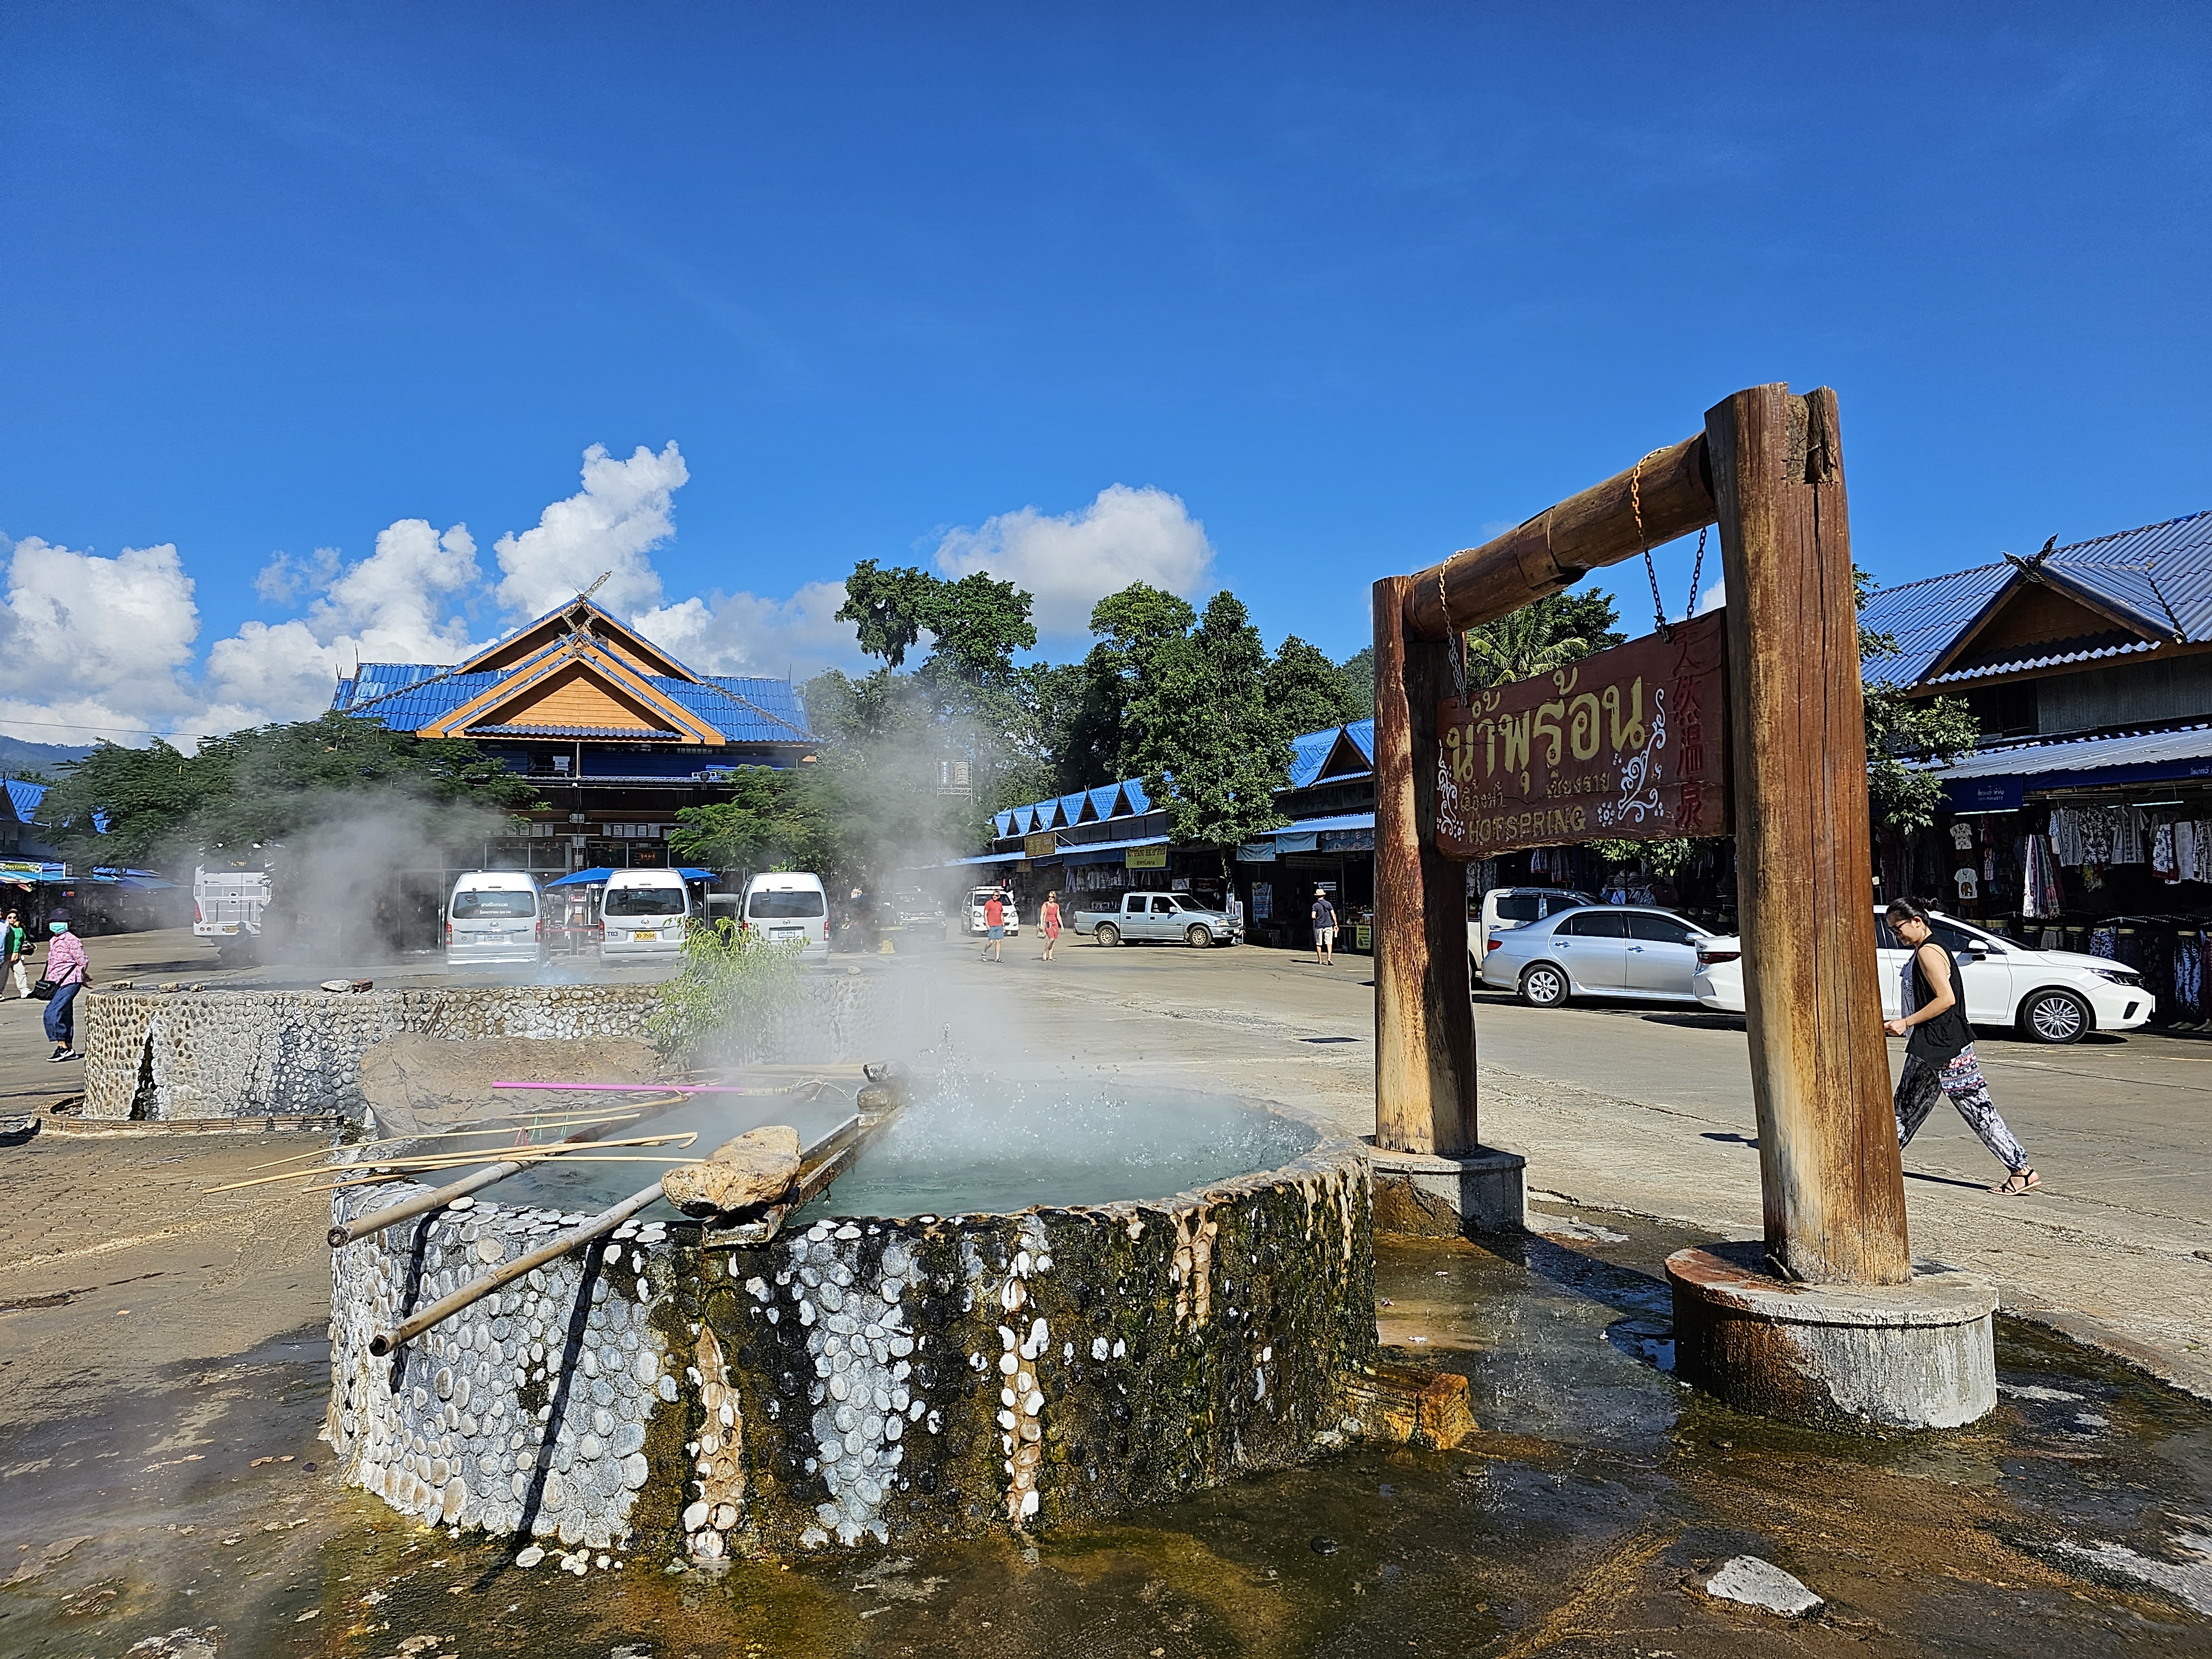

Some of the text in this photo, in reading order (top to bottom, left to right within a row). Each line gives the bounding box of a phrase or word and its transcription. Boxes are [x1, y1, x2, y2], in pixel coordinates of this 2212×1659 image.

[1446, 666, 1645, 795] น้ำพุร้อน
[1547, 769, 1610, 798] เชียงราย
[1672, 620, 1704, 828] 天然温泉
